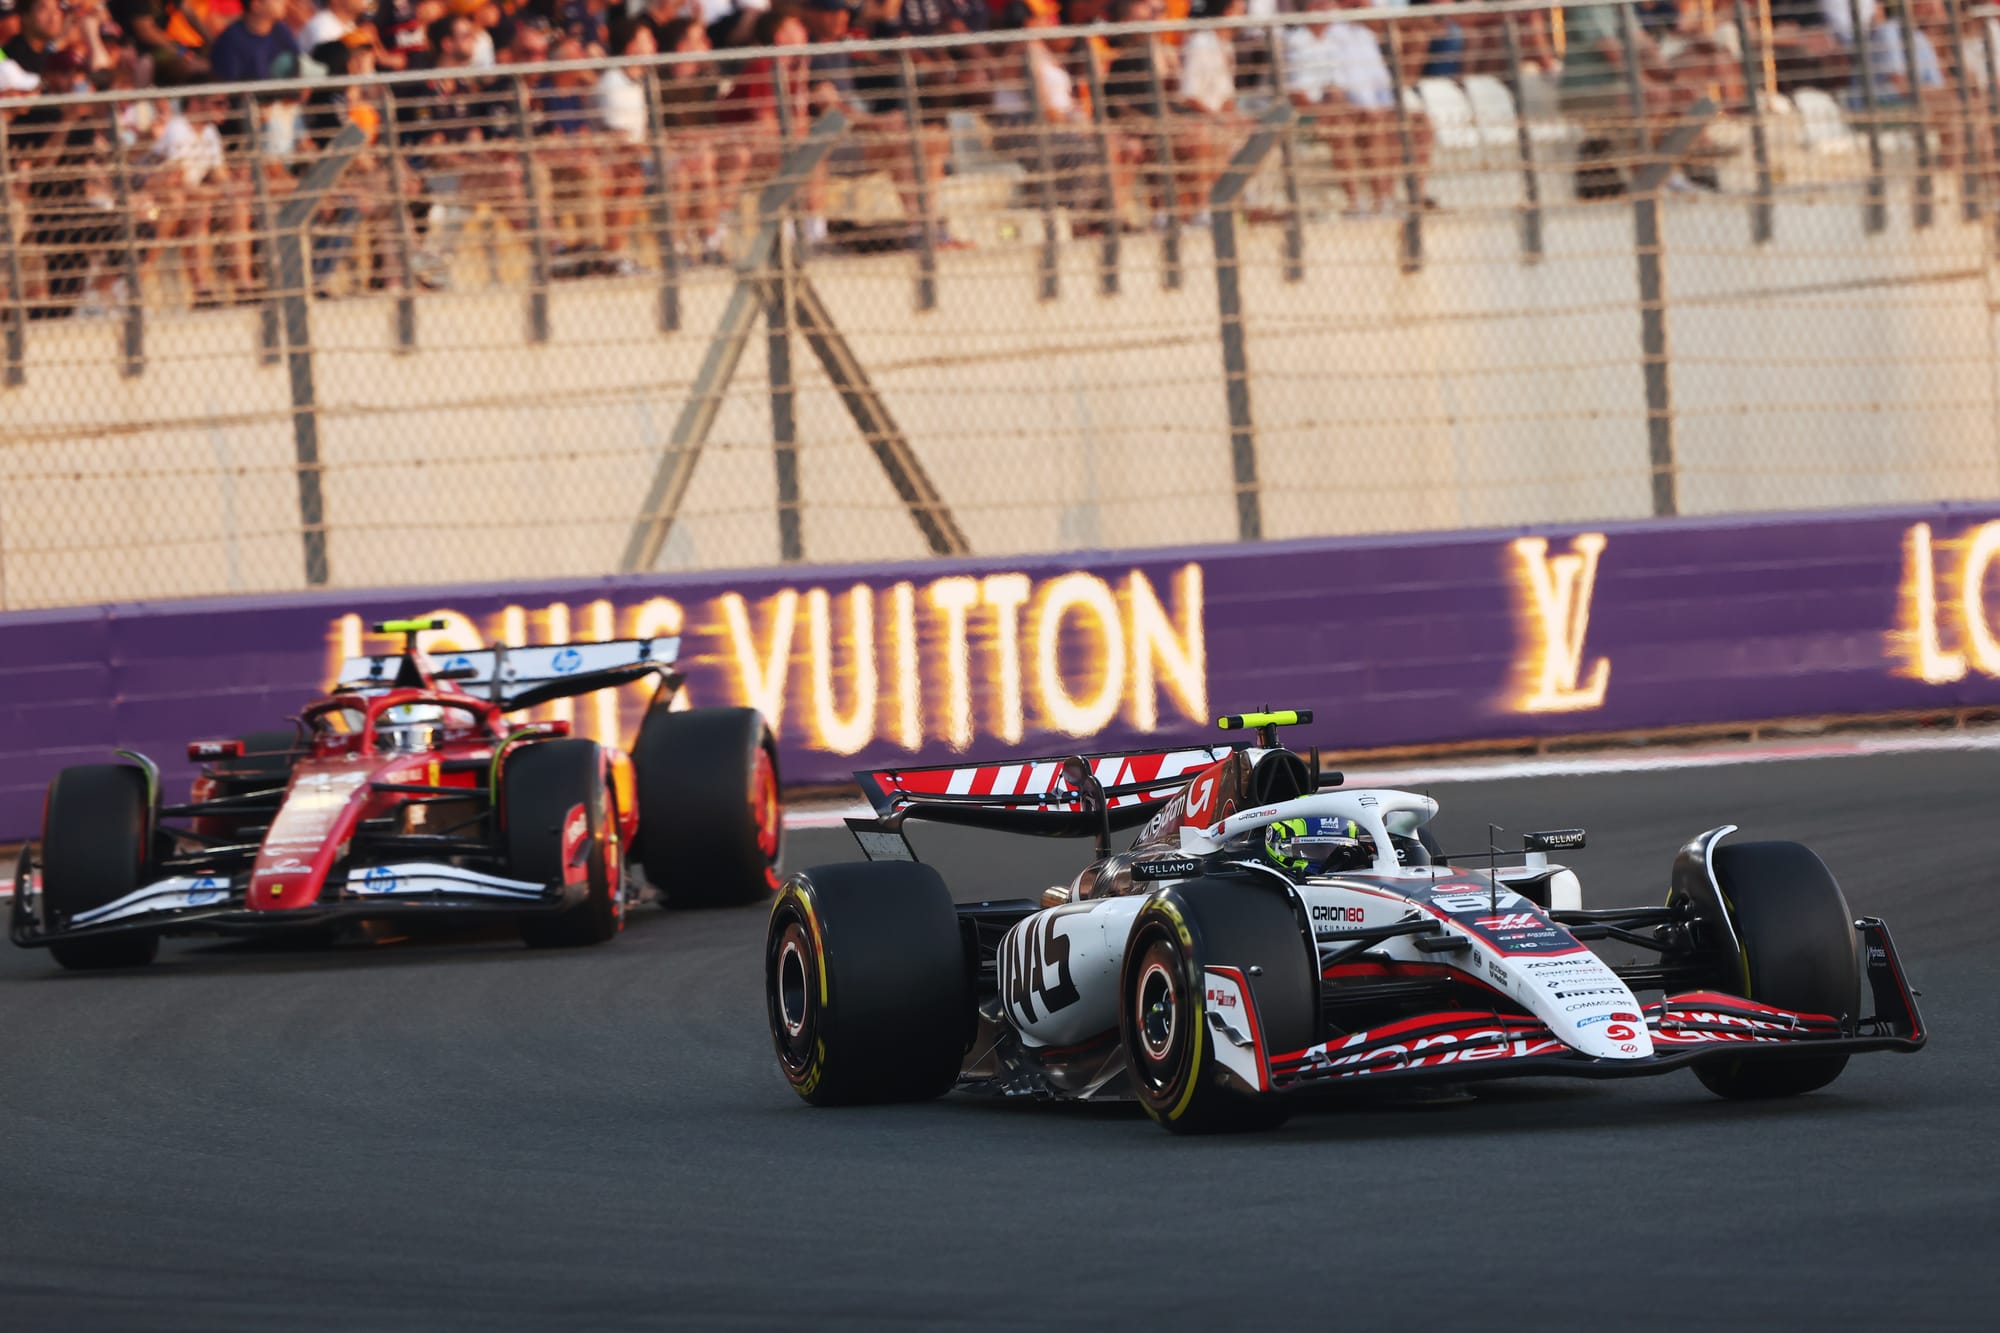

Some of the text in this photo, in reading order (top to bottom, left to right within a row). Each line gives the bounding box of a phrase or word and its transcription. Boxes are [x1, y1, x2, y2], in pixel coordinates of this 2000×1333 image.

[718, 562, 1210, 756] VUITTON
[1542, 833, 1583, 844] VELLAMO
[1141, 862, 1195, 874] VELLAMO
[1312, 905, 1365, 922] ORION180
